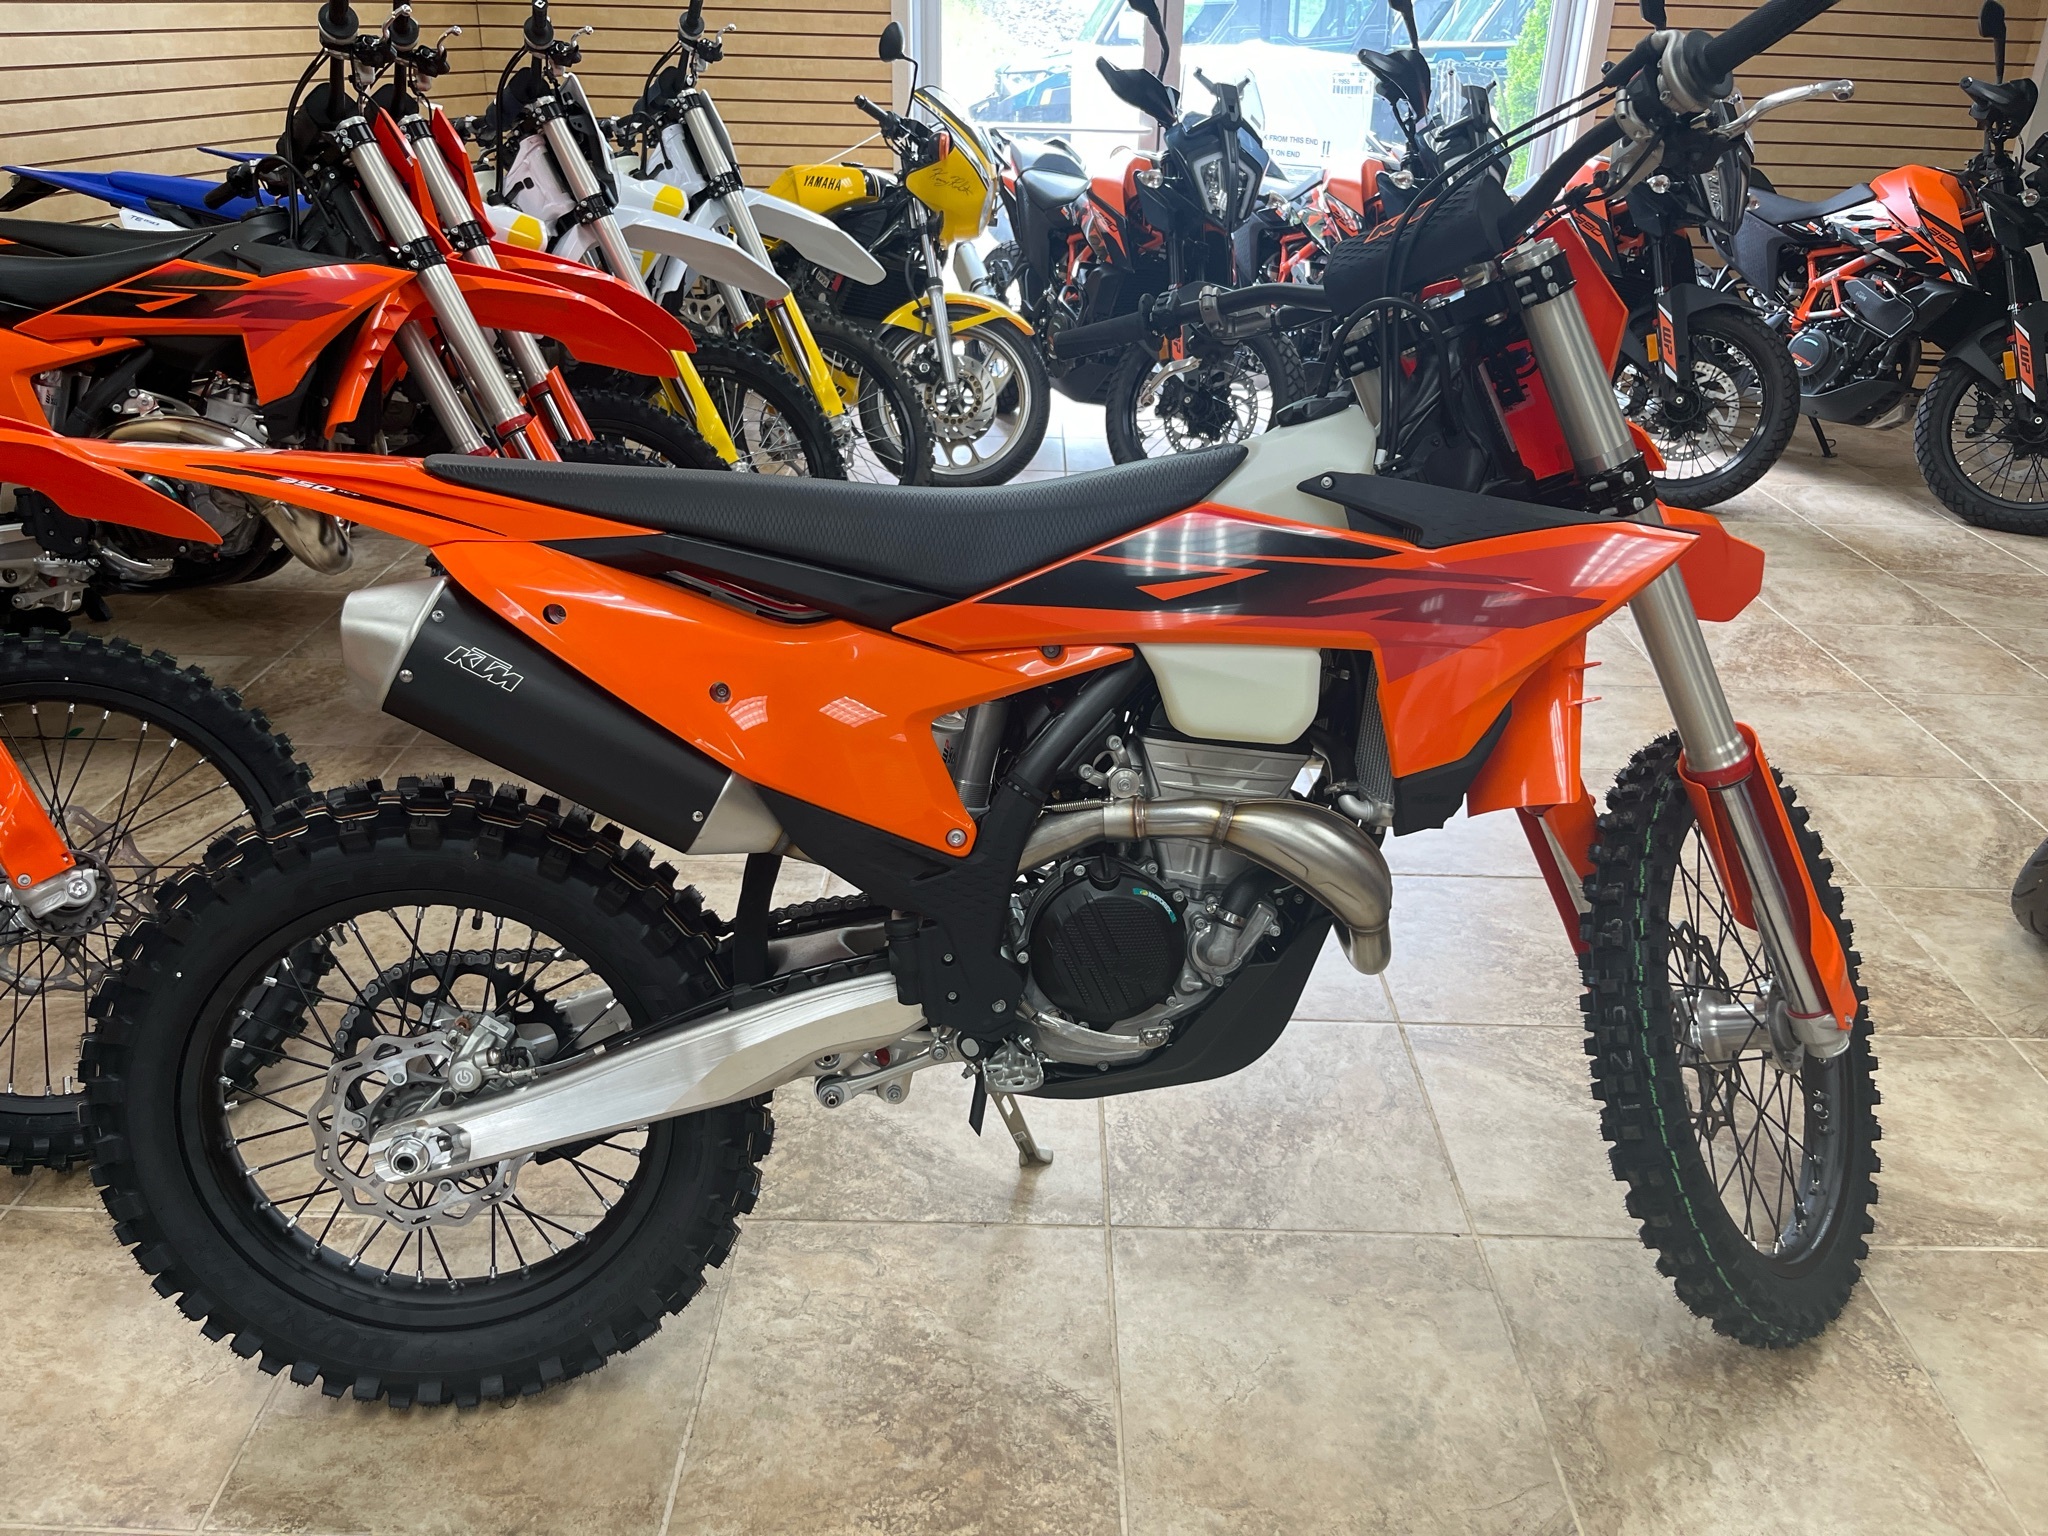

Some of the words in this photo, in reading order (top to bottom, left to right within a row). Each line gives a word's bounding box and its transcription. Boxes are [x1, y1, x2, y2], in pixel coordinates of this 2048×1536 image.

[1269, 134, 1288, 143] FROM
[1289, 136, 1304, 144] THIS
[1305, 137, 1319, 146] END
[1275, 149, 1285, 157] ON
[1286, 150, 1301, 158] END
[803, 175, 842, 191] YAMAHA
[1574, 214, 1603, 237] 390
[1930, 226, 1960, 250] 390
[1662, 326, 1673, 355] WP
[2020, 344, 2031, 374] WP
[443, 644, 525, 693] KTM
